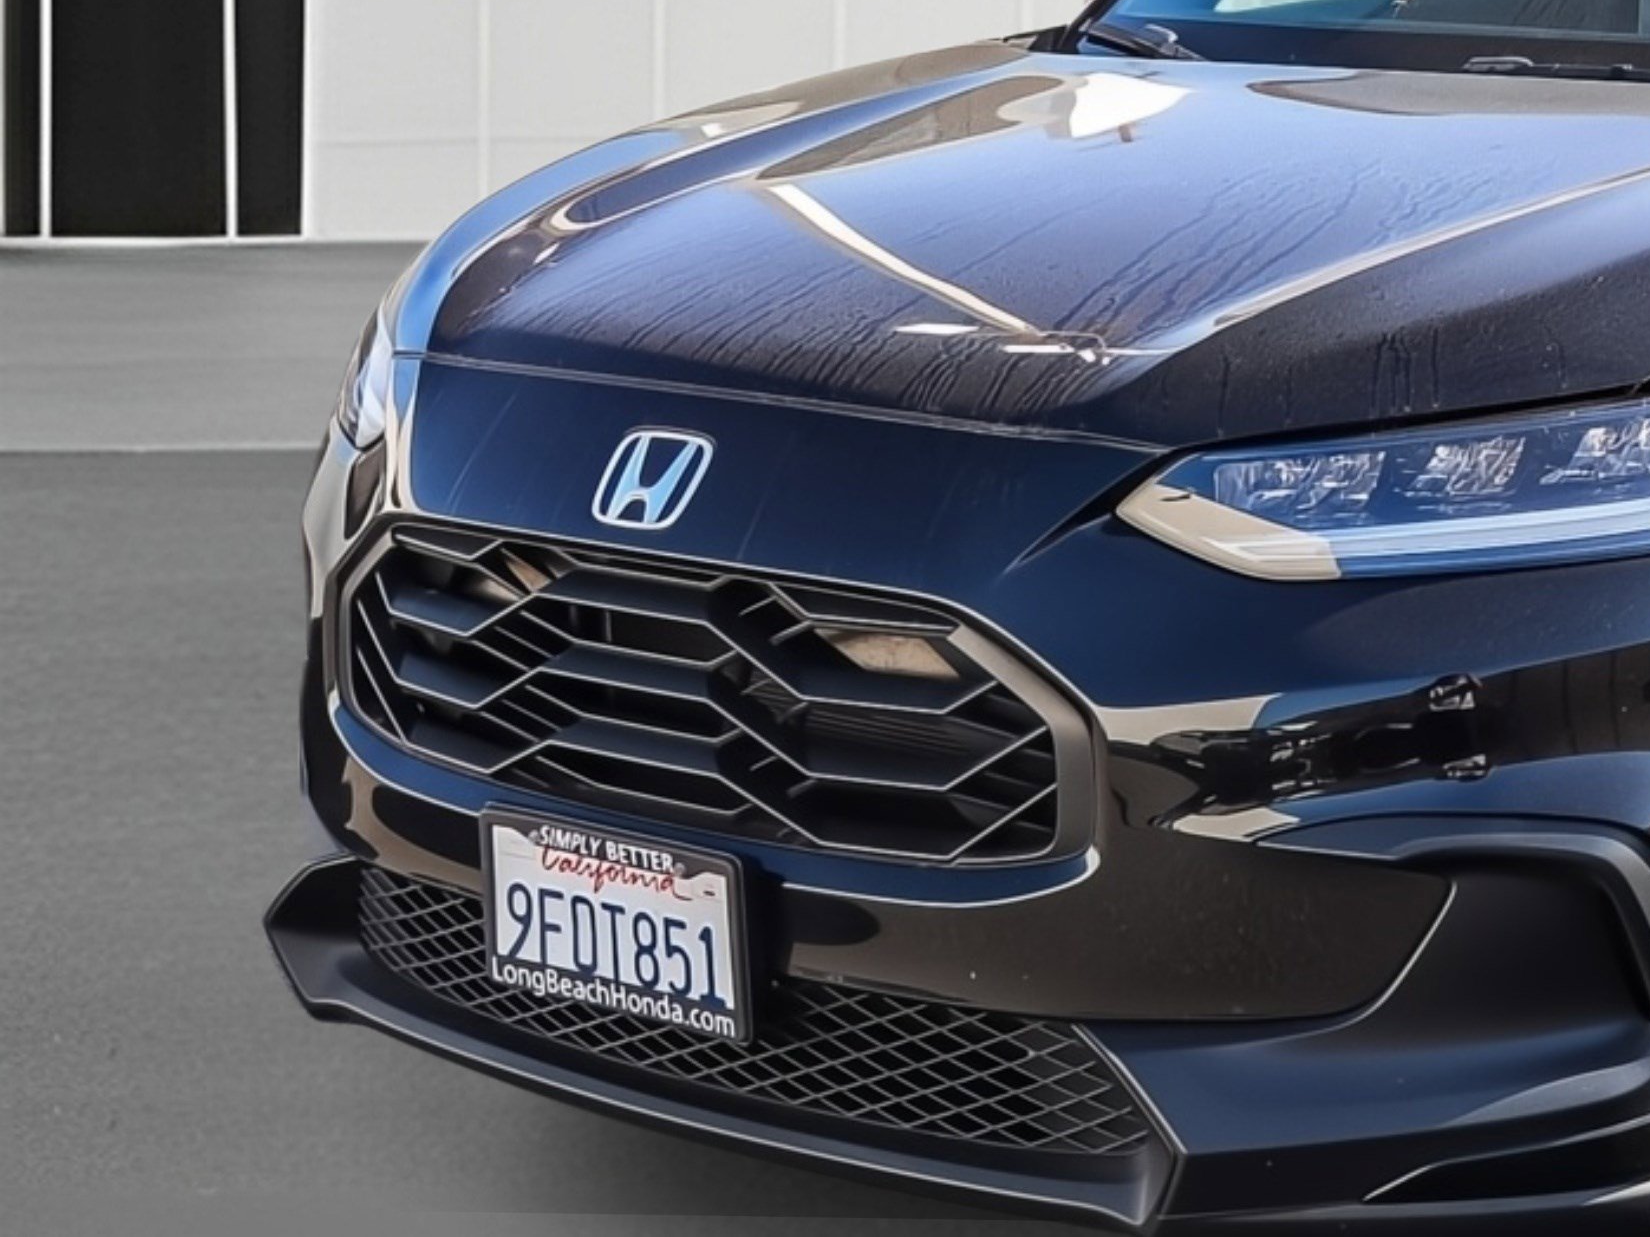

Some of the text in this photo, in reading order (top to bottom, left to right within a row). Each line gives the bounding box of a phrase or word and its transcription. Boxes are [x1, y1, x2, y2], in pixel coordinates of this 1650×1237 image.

[538, 824, 675, 874] SIMPLY BETTER
[490, 955, 736, 1039] LongBeachHonda.com
